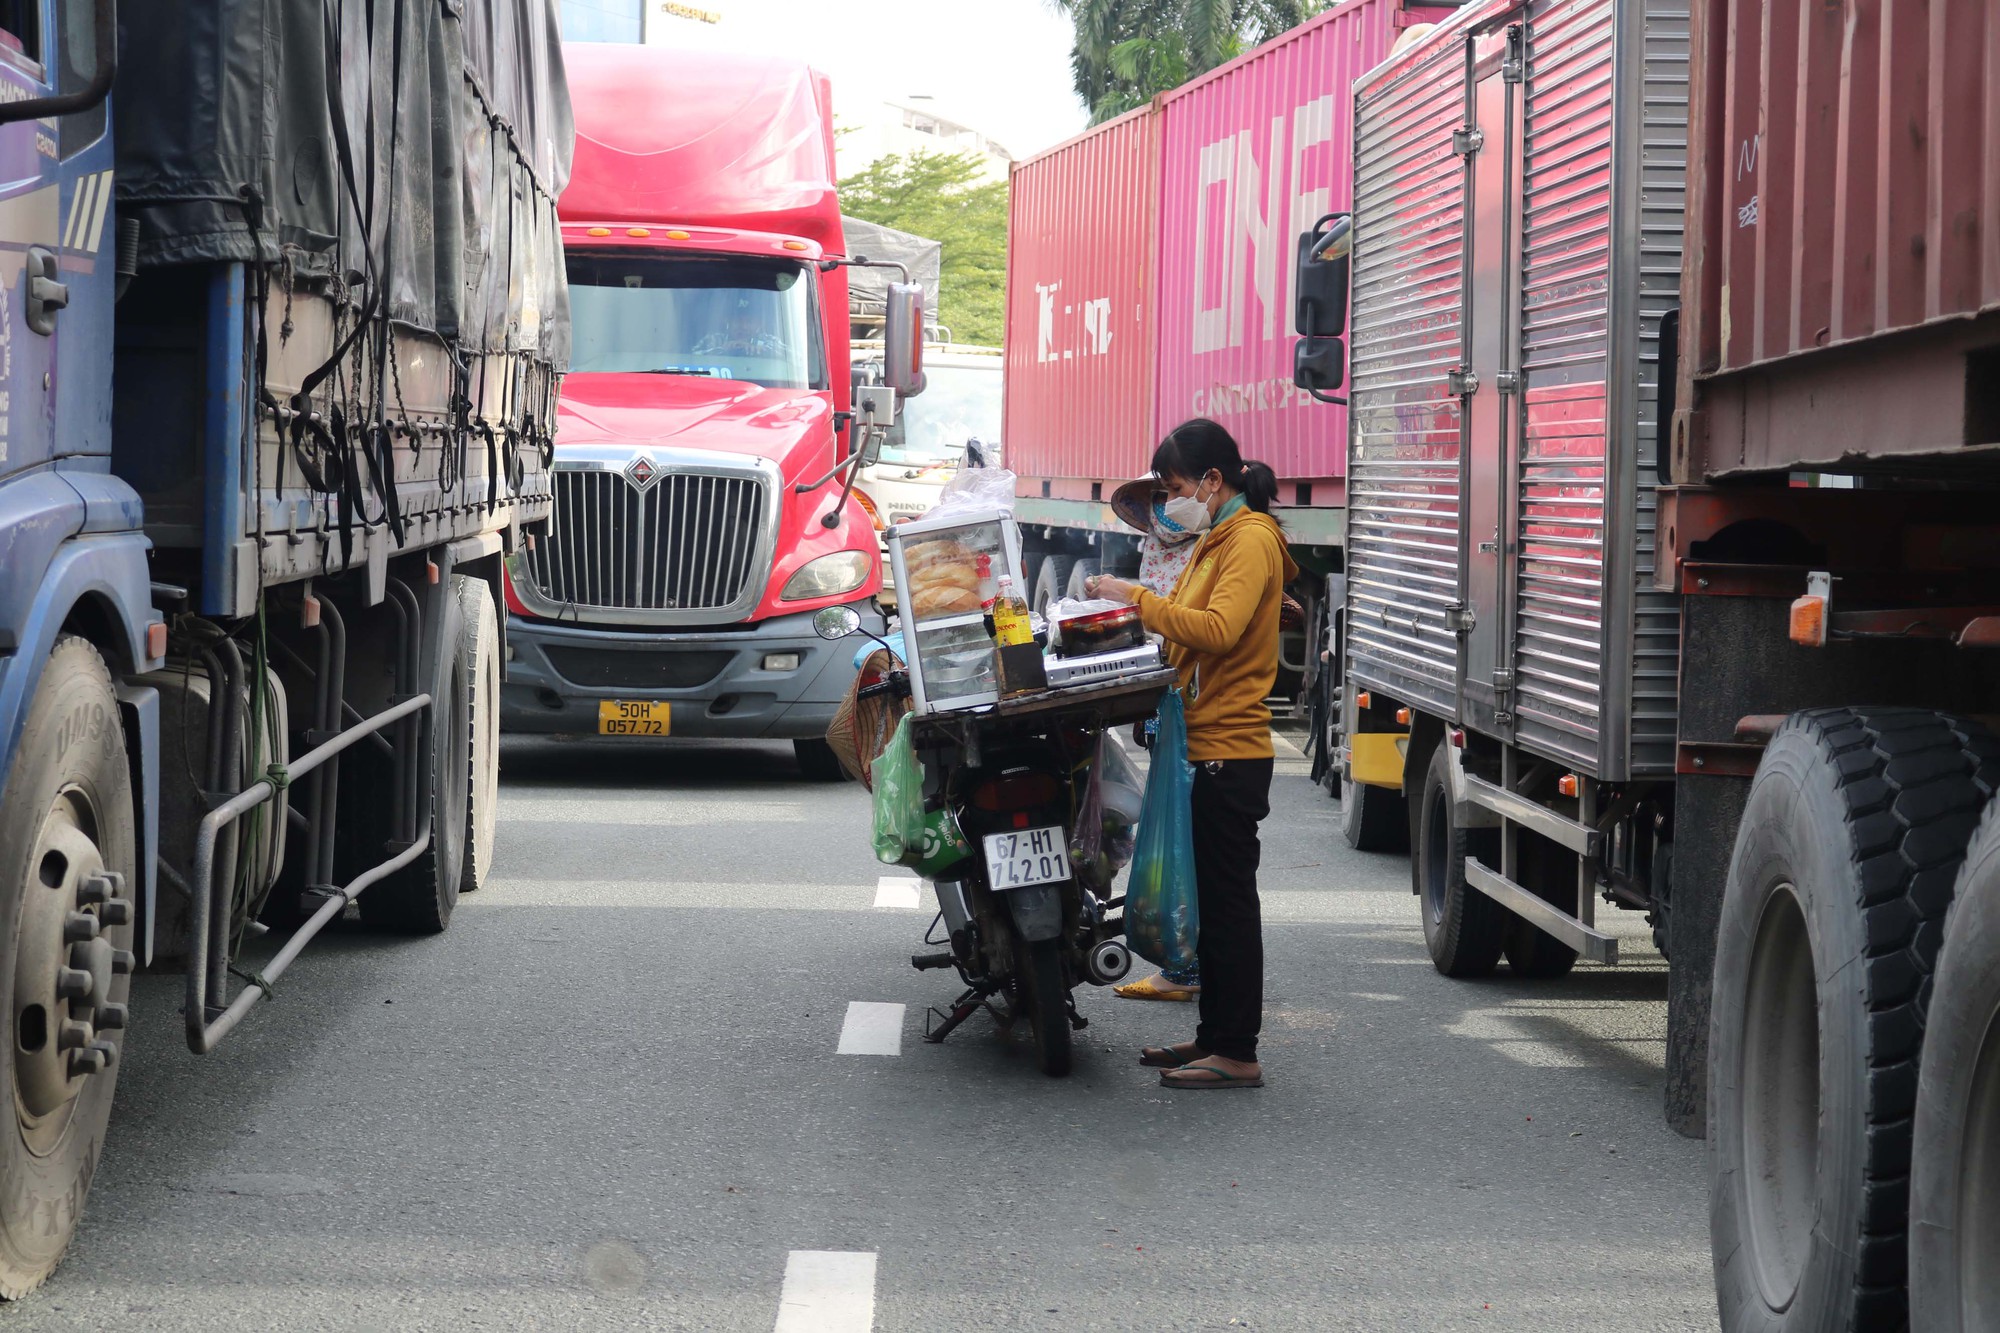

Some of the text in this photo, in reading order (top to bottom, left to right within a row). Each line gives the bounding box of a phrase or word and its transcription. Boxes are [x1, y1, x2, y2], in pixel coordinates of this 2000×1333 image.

[888, 502, 927, 511] HINO
[620, 703, 650, 718] 50H
[607, 720, 662, 734] 057.72
[938, 820, 956, 847] gojek
[995, 829, 1053, 859] 67-H1
[991, 854, 1065, 887] 742.01
